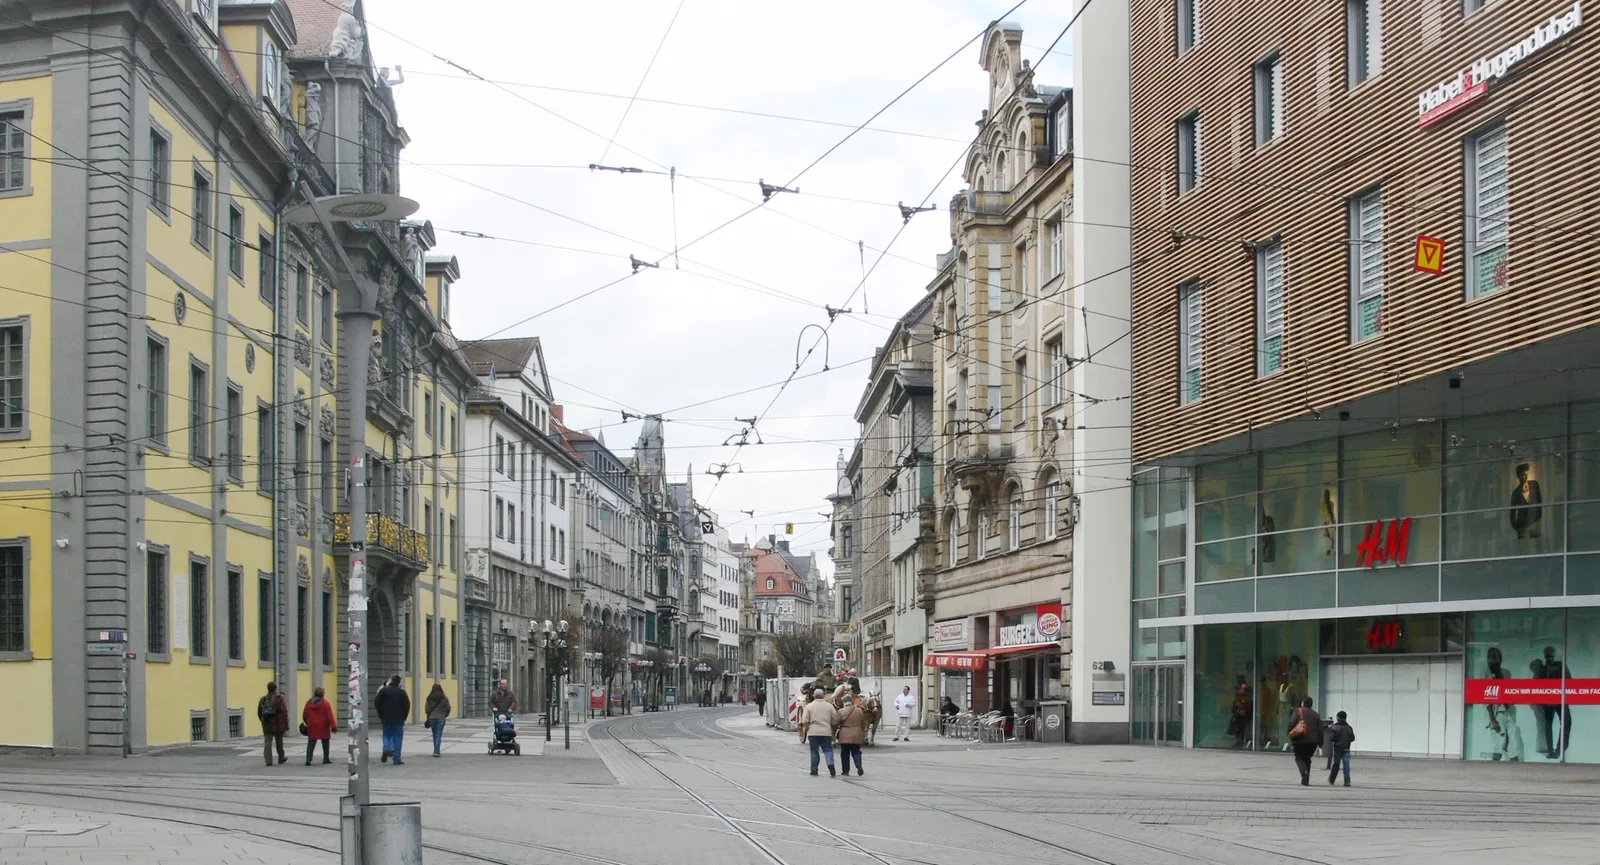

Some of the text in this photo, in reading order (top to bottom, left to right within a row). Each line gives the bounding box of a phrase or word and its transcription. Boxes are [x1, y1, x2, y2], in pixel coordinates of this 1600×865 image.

[1356, 517, 1411, 568] H&M
[1000, 624, 1031, 646] BURGER
[1041, 621, 1059, 632] KING
